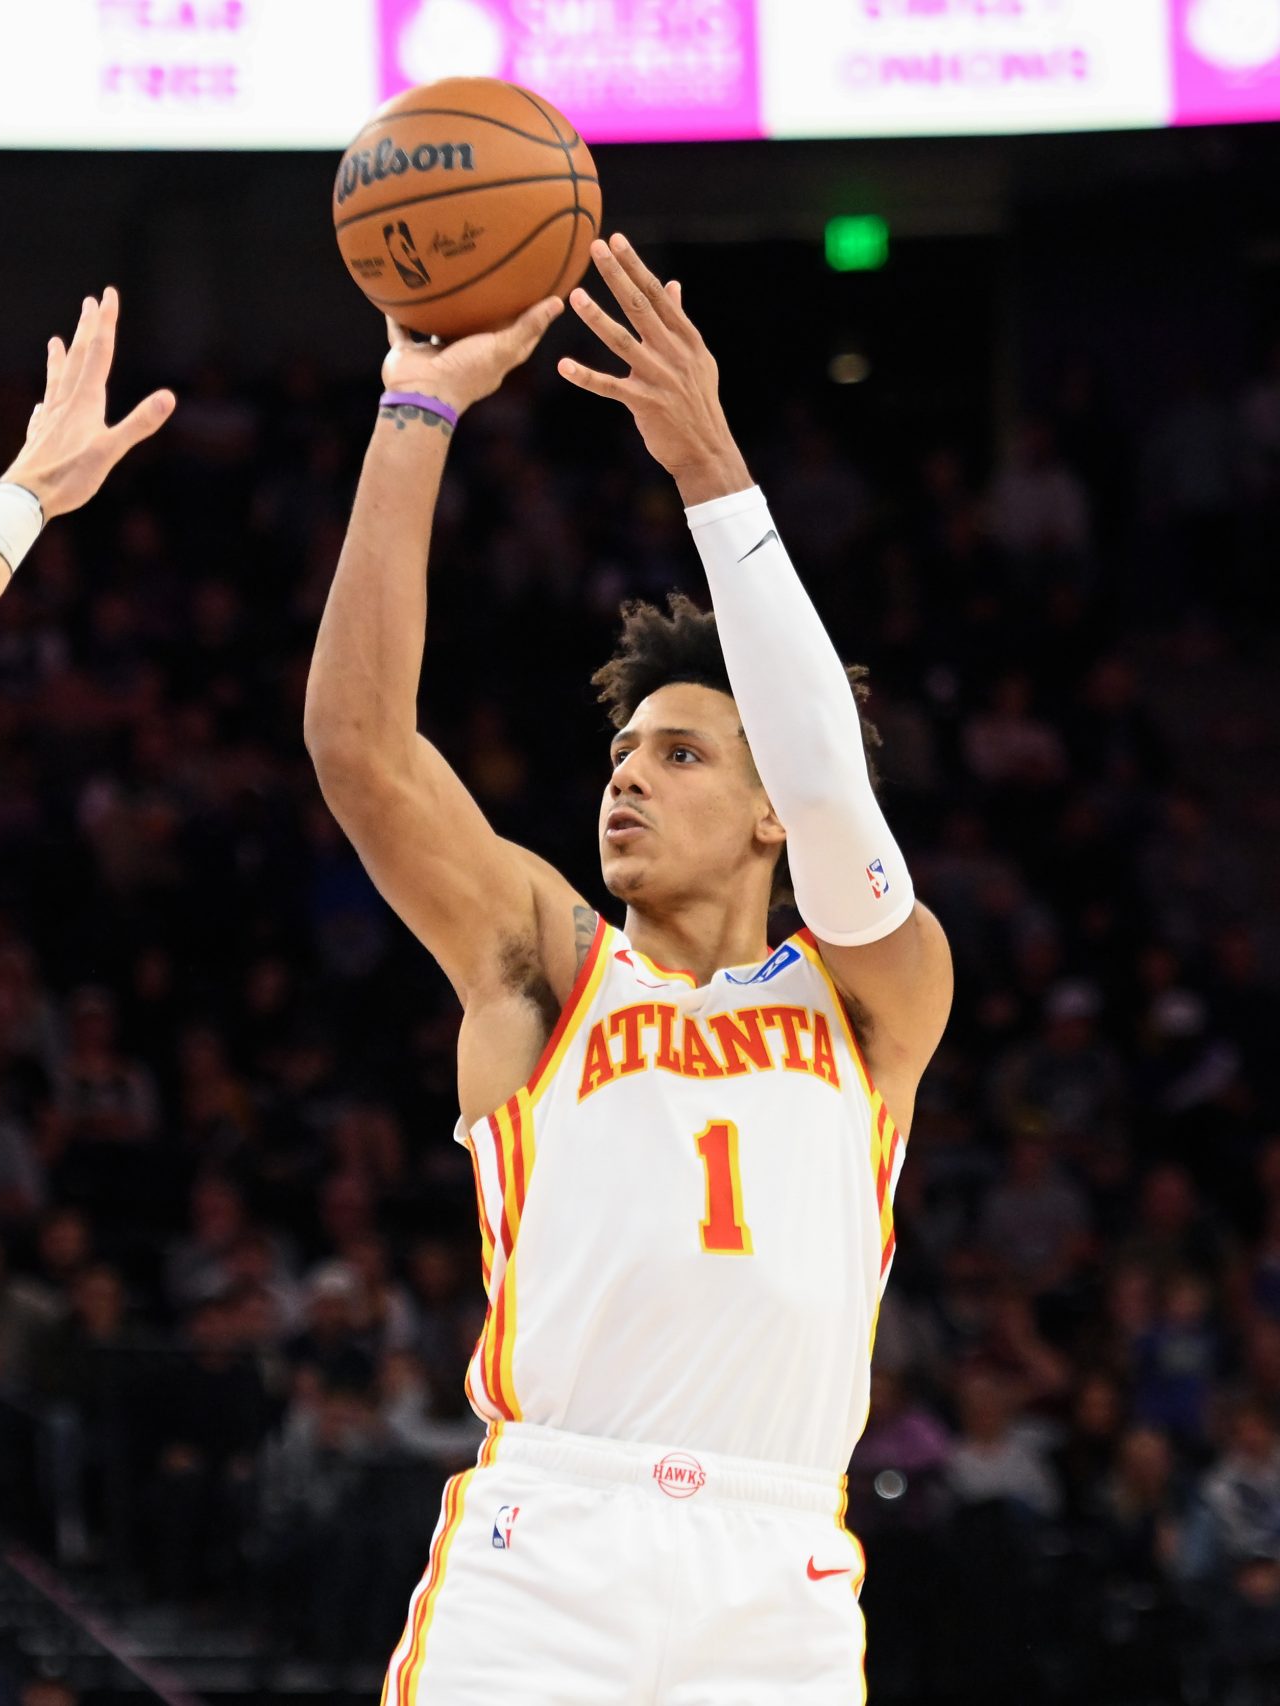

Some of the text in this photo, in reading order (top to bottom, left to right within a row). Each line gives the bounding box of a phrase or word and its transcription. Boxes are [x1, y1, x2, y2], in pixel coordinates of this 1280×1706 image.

[577, 1001, 842, 1105] ATLANTA
[693, 1119, 755, 1256] 1
[652, 1463, 707, 1487] HAWKS
